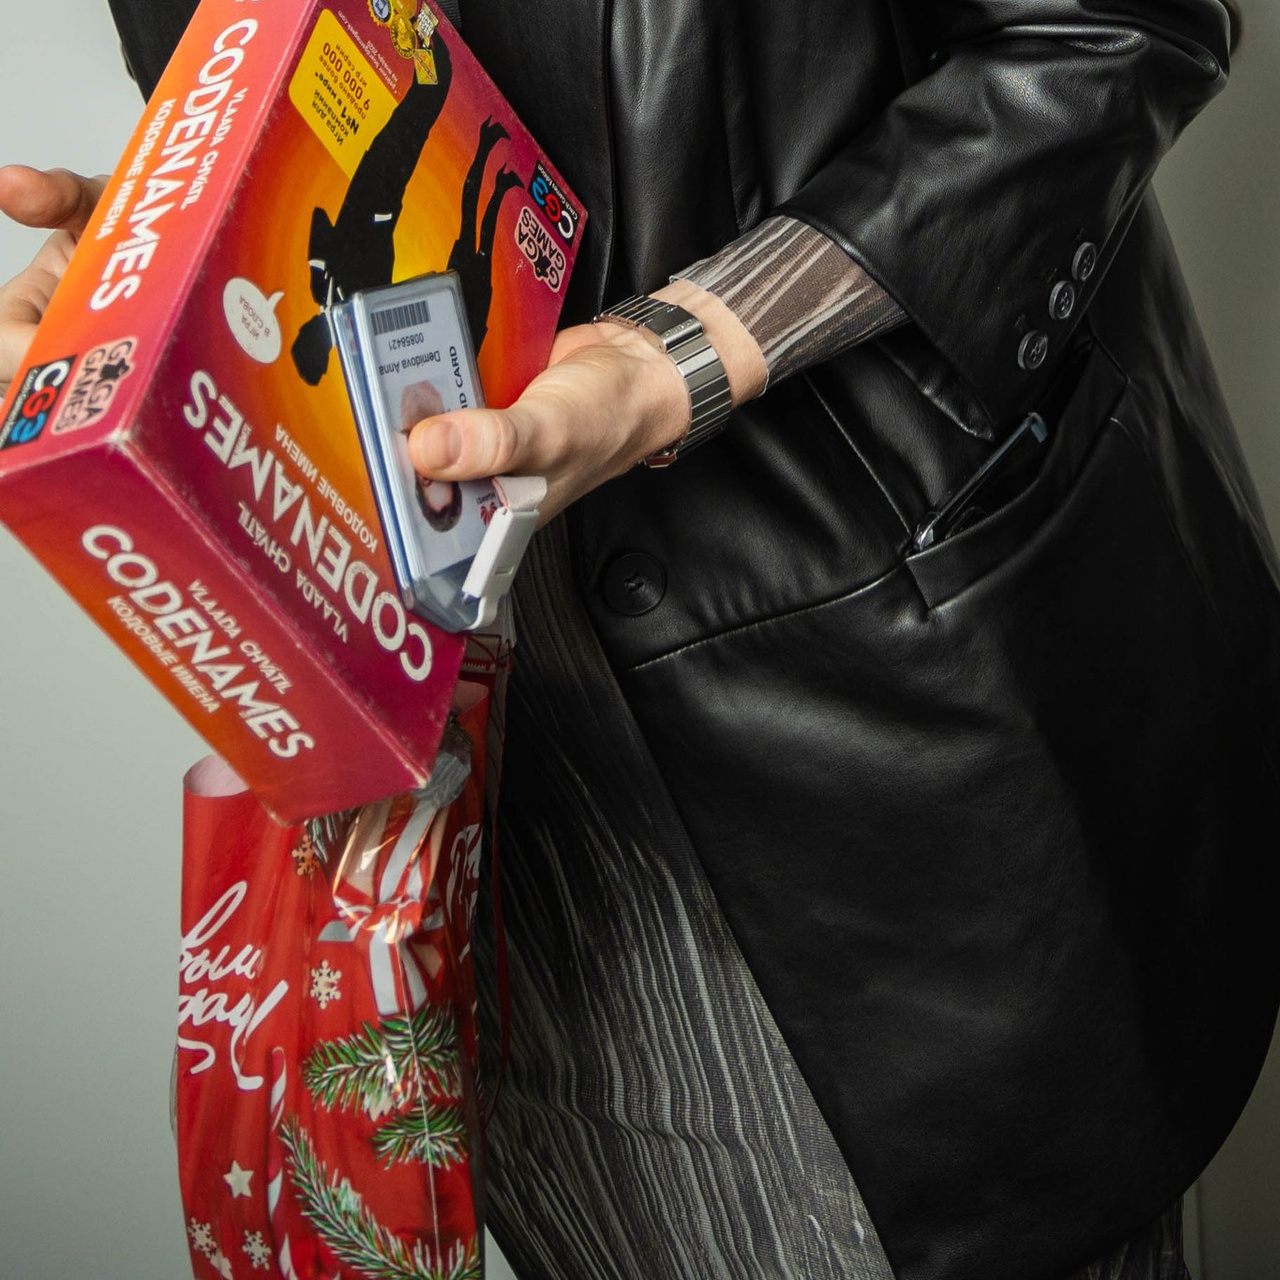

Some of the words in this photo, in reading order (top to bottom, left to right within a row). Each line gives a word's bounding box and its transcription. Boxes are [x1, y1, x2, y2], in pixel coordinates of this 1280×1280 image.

[317, 53, 338, 84] более
[321, 39, 343, 73] 000
[311, 98, 326, 121] для
[338, 80, 366, 120] продано
[342, 68, 363, 101] 000
[120, 97, 177, 180] КОДОВЫЕ
[208, 87, 248, 147] VLAADA
[313, 88, 349, 138] компаний
[325, 117, 344, 146] Игра
[89, 18, 258, 311] CODENAMES
[179, 148, 222, 210] CHVÁTIL
[93, 177, 138, 241] ИМЕНА
[520, 205, 565, 274] GAMES
[238, 294, 264, 329] СЛОВА
[240, 314, 259, 340] ИГРА
[379, 361, 400, 376] Anna
[389, 332, 424, 351] 00858421
[401, 350, 441, 369] Demidova
[449, 346, 463, 388] CARD
[459, 392, 468, 409] ID
[272, 421, 318, 484] ИМЕНА
[182, 368, 434, 682] CODENAMES
[233, 499, 291, 579] CHVÁTIL
[316, 471, 378, 555] КОДОВЫЕ
[293, 568, 350, 644] VLAADA
[80, 524, 315, 758] CODENAMES
[102, 595, 181, 666] КОДОВЫЕ
[168, 664, 224, 712] ИМЕНА
[181, 578, 247, 639] VLAADA
[235, 638, 298, 695] CHVÁTIL
